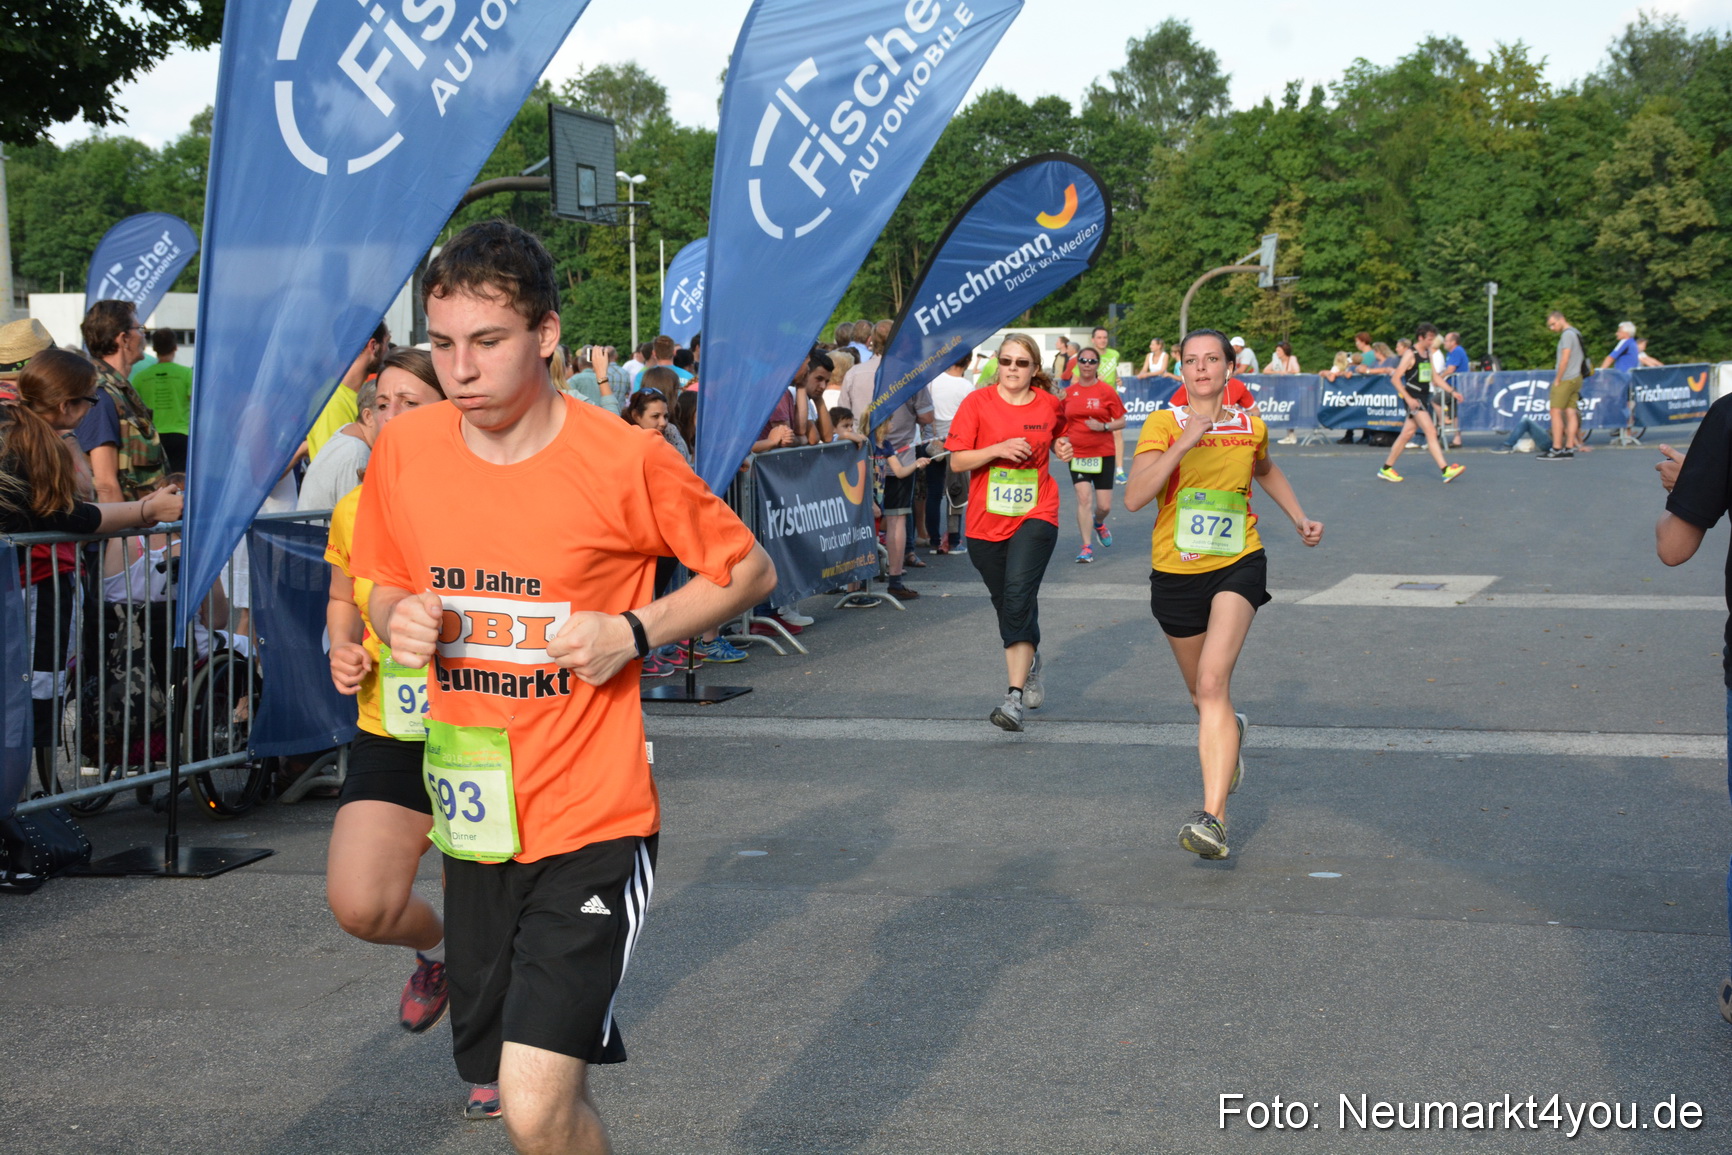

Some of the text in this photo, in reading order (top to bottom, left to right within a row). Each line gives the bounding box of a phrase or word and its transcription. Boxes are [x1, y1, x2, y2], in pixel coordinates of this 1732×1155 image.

[430, 0, 518, 118] AUTO
[788, 0, 949, 198] Fische
[849, 1, 974, 195] AUTOMOBILE
[112, 229, 174, 301] Fischer
[1004, 222, 1099, 292] Druck und Medien
[914, 232, 1053, 336] Frischmann
[868, 335, 962, 412] www.frischmann-net.de
[1323, 391, 1397, 407] Frischmann
[1635, 384, 1691, 402] Frischmann
[1367, 407, 1385, 416] Druck
[1386, 408, 1397, 416] und
[1075, 457, 1099, 467] 1588
[993, 486, 1033, 503] 1485
[765, 494, 848, 540] Frischmann
[1190, 514, 1233, 539] 872
[430, 566, 541, 596] 30 Jahre
[452, 831, 477, 841] Dirner
[580, 905, 612, 915] adidas
